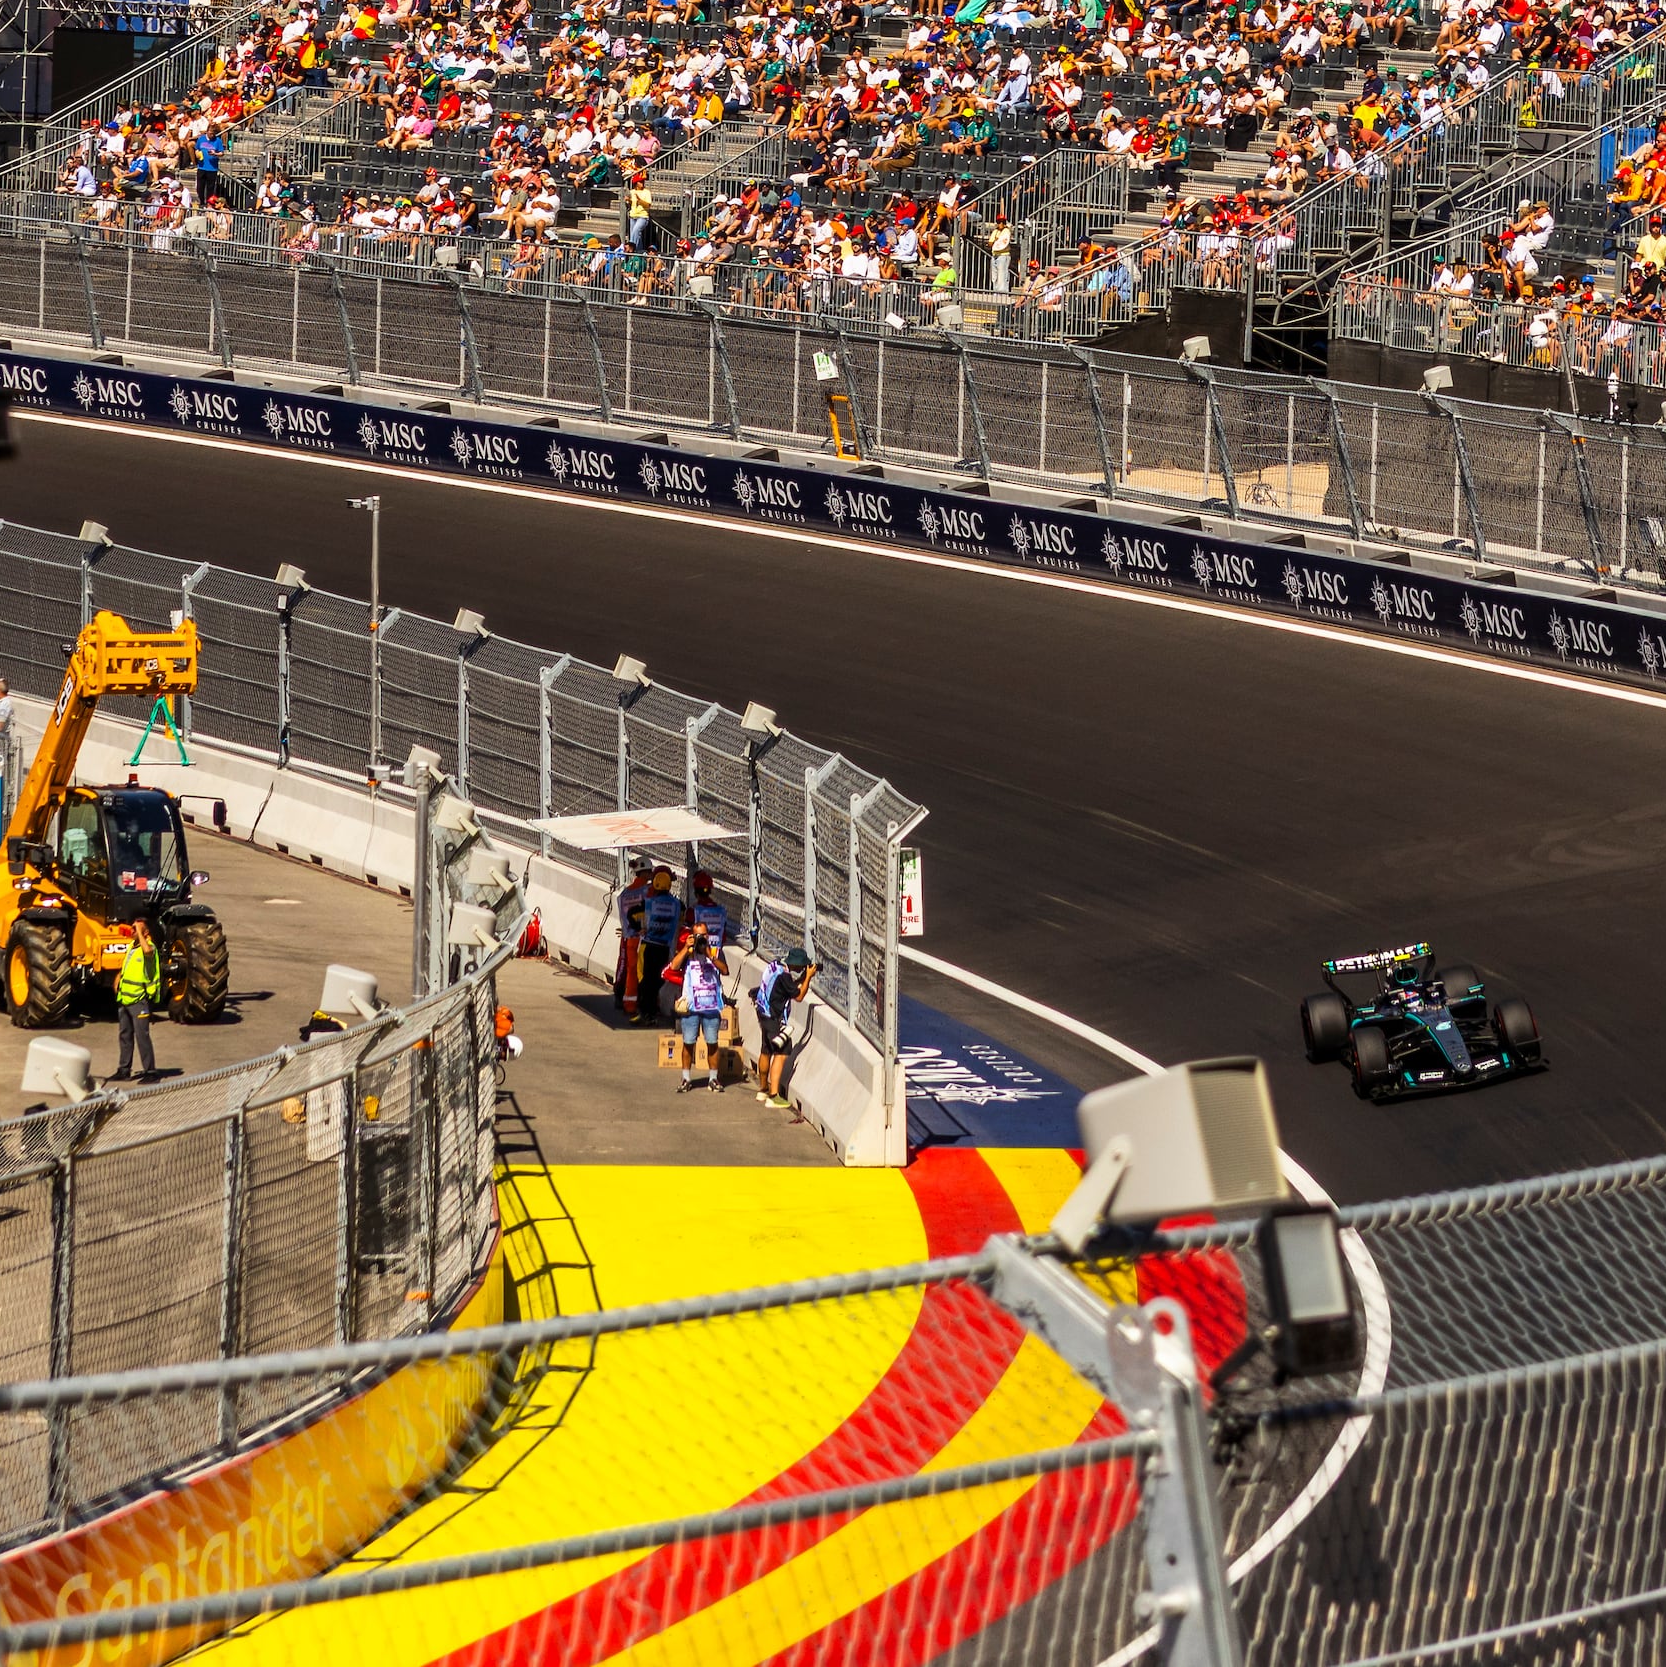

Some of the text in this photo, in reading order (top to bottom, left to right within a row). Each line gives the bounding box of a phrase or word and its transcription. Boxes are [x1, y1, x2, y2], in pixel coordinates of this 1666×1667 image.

[0, 364, 47, 392] MSC
[95, 378, 142, 406] MSC
[100, 406, 145, 419] CRUISES
[192, 391, 238, 421] MSC
[197, 421, 241, 435] CRUISES
[285, 406, 331, 435] MSC
[290, 435, 334, 449] CRUISES
[380, 421, 425, 451] MSC
[385, 451, 429, 464] CRUISES
[472, 434, 519, 463] MSC
[478, 464, 522, 477] CRUISES
[569, 448, 615, 479] MSC
[574, 478, 618, 493] CRUISES
[661, 461, 706, 493] MSC
[667, 493, 710, 508] CRUISES
[755, 476, 801, 508] MSC
[761, 508, 805, 523] CRUISES
[846, 491, 892, 523] MSC
[852, 523, 895, 538] CRUISES
[939, 507, 985, 540] MSC
[945, 541, 989, 556] CRUISES
[1030, 522, 1075, 555] MSC
[1036, 557, 1080, 571] CRUISES
[1123, 537, 1168, 571] MSC
[1129, 572, 1172, 588] CRUISES
[1211, 552, 1256, 587] MSC
[1218, 588, 1261, 604] CRUISES
[1303, 569, 1348, 604] MSC
[1309, 605, 1352, 622] CRUISES
[1391, 584, 1435, 620] MSC
[1397, 621, 1439, 638] CRUISES
[1481, 602, 1526, 639] MSC
[1488, 639, 1530, 657] CRUISES
[1568, 618, 1613, 656] MSC
[144, 659, 158, 671] JCB
[1576, 657, 1619, 675] CRUISES
[55, 677, 75, 726] JCB
[904, 872, 918, 880] XIT
